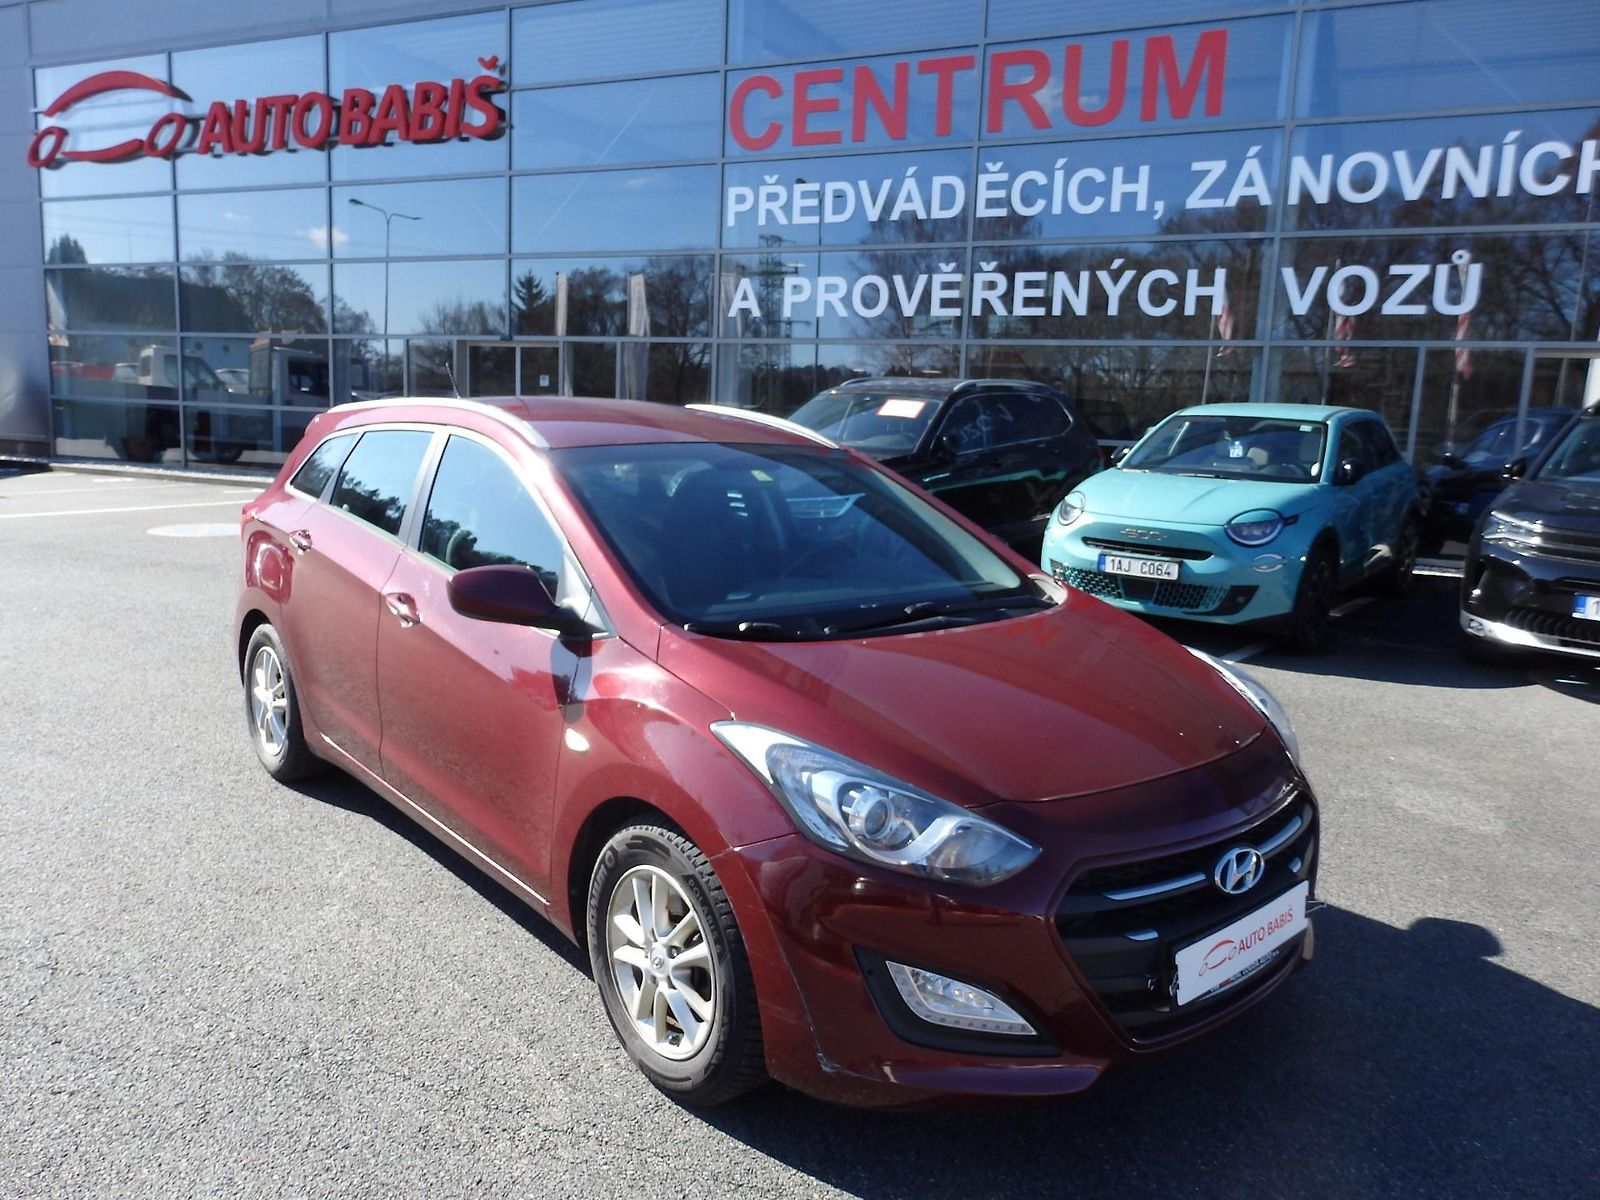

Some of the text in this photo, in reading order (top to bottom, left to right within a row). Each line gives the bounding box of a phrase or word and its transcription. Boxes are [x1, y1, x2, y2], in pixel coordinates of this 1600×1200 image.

[197, 55, 501, 154] AUTO BABIŠ
[728, 29, 1228, 152] CENTRUM
[726, 157, 1165, 227] PŘEDVÁDĚCÍCH,
[728, 248, 1483, 318] A PROVĚŘENÝCH VOZŮ
[1238, 907, 1293, 954] AUTO BABIŠ
